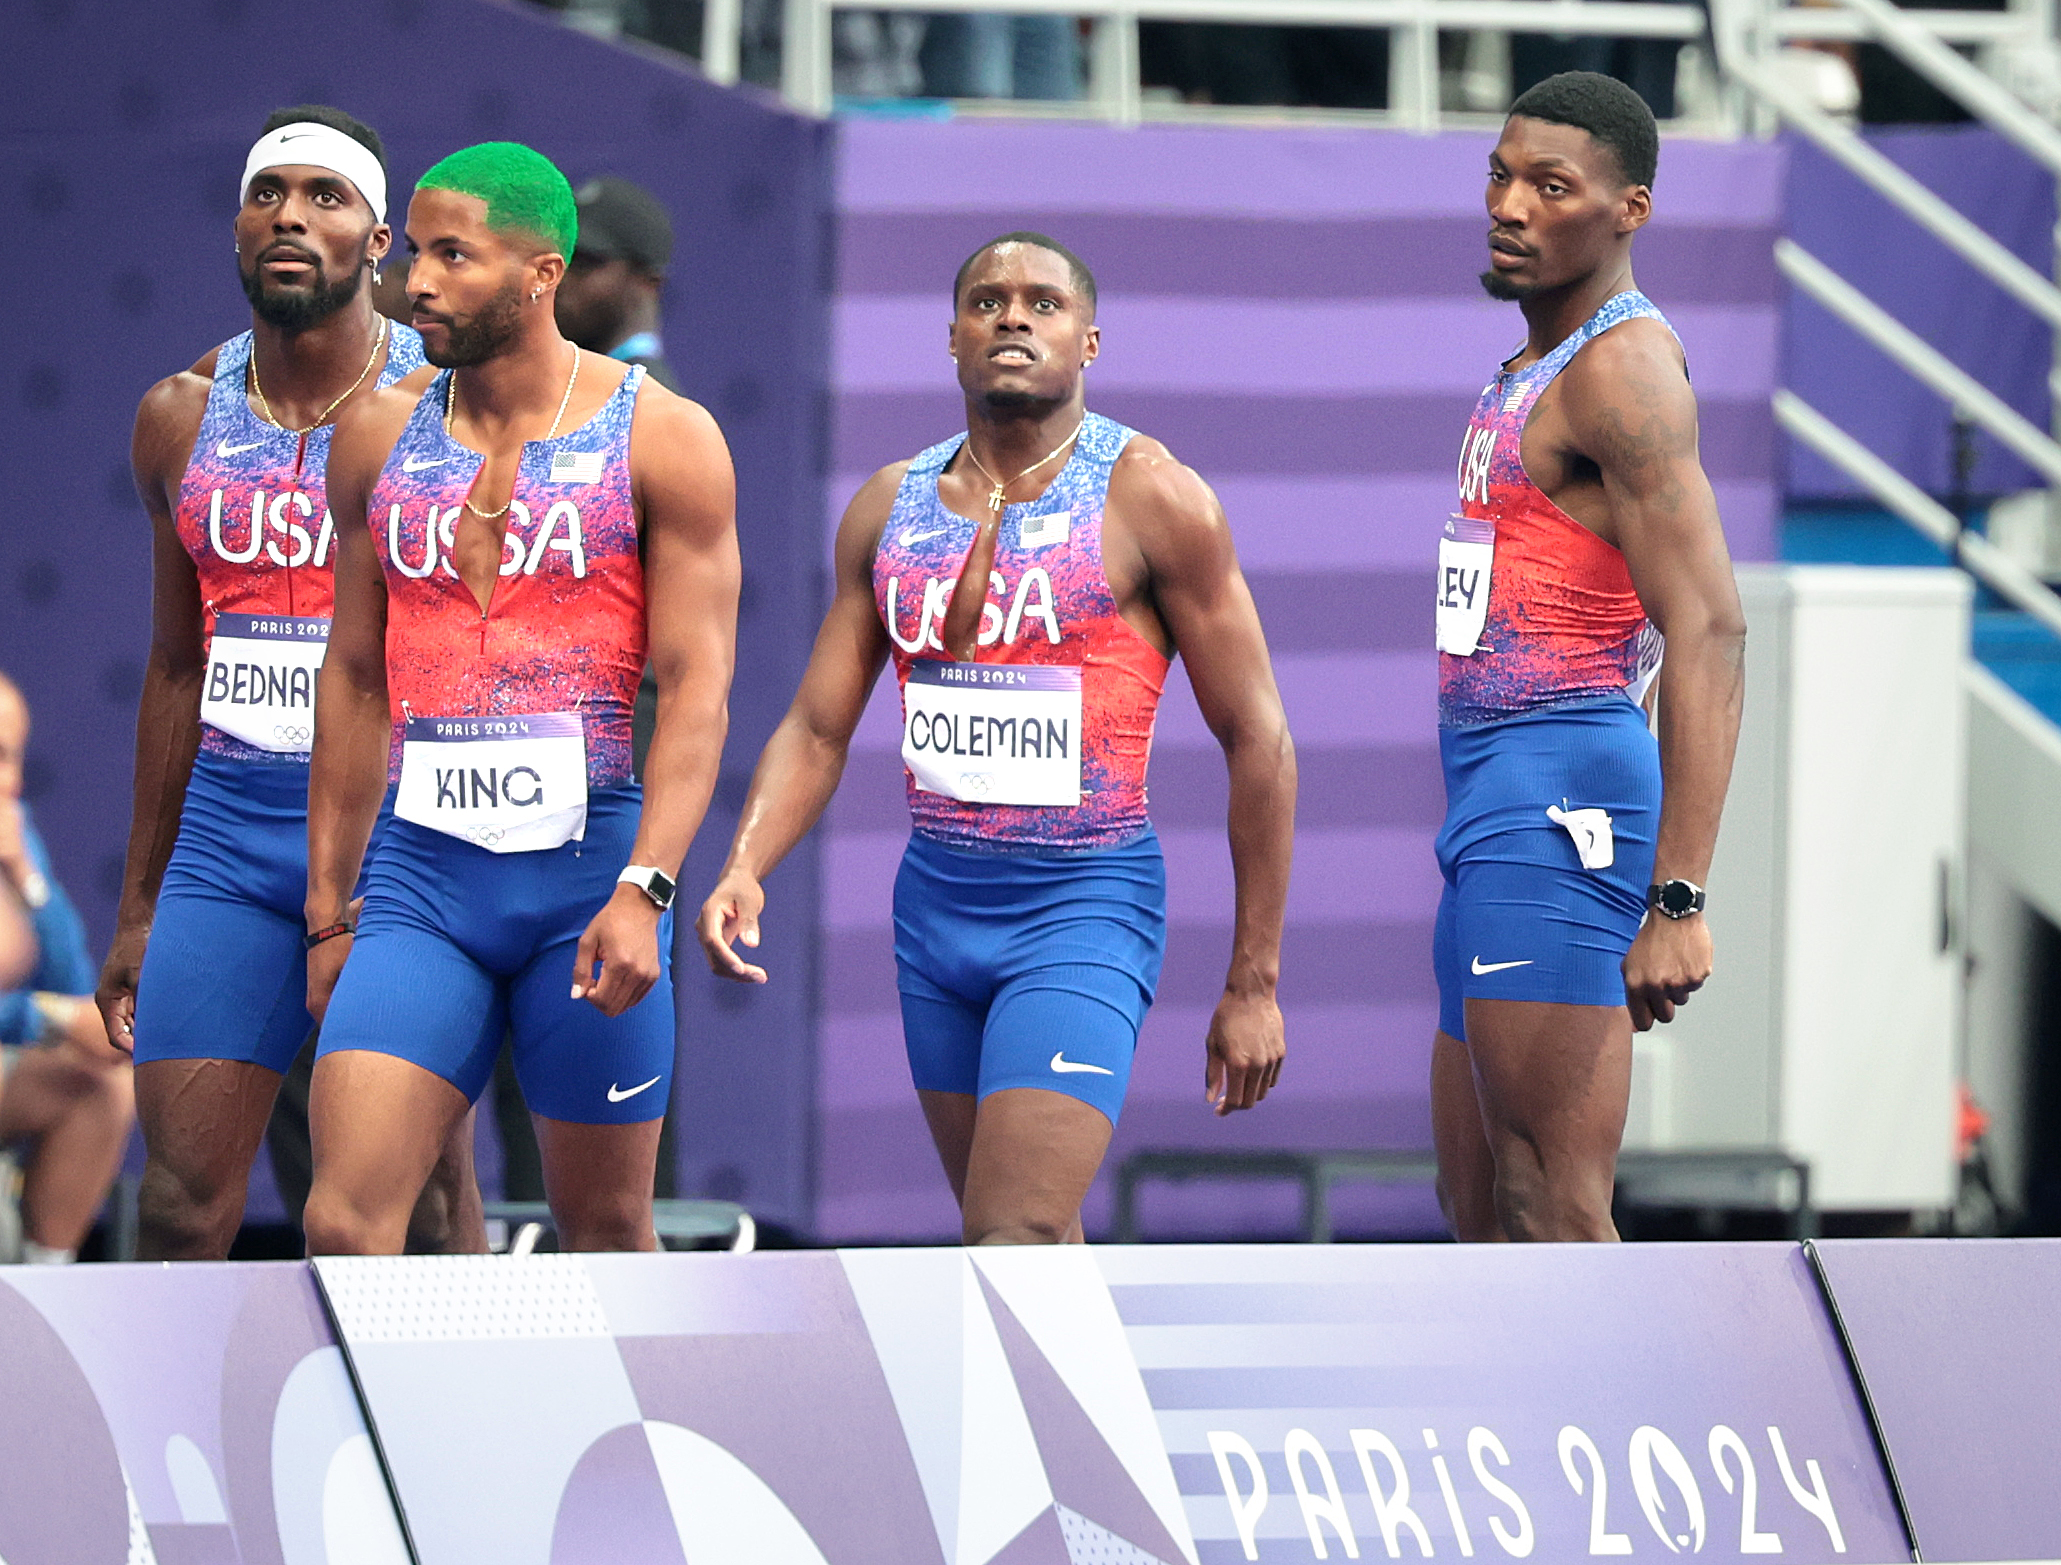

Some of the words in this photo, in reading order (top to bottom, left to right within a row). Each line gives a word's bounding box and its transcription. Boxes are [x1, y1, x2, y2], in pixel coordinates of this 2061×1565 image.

[1457, 425, 1497, 504] USA
[251, 621, 293, 635] PARIS
[208, 662, 321, 708] BEDNA
[941, 668, 977, 682] PARIS
[983, 670, 1026, 684] 2024
[436, 722, 479, 735] PARIS
[484, 721, 529, 735] 2024
[910, 710, 1067, 759] COLEMAN
[436, 766, 543, 809] KING
[1557, 1425, 1846, 1554] 2024
